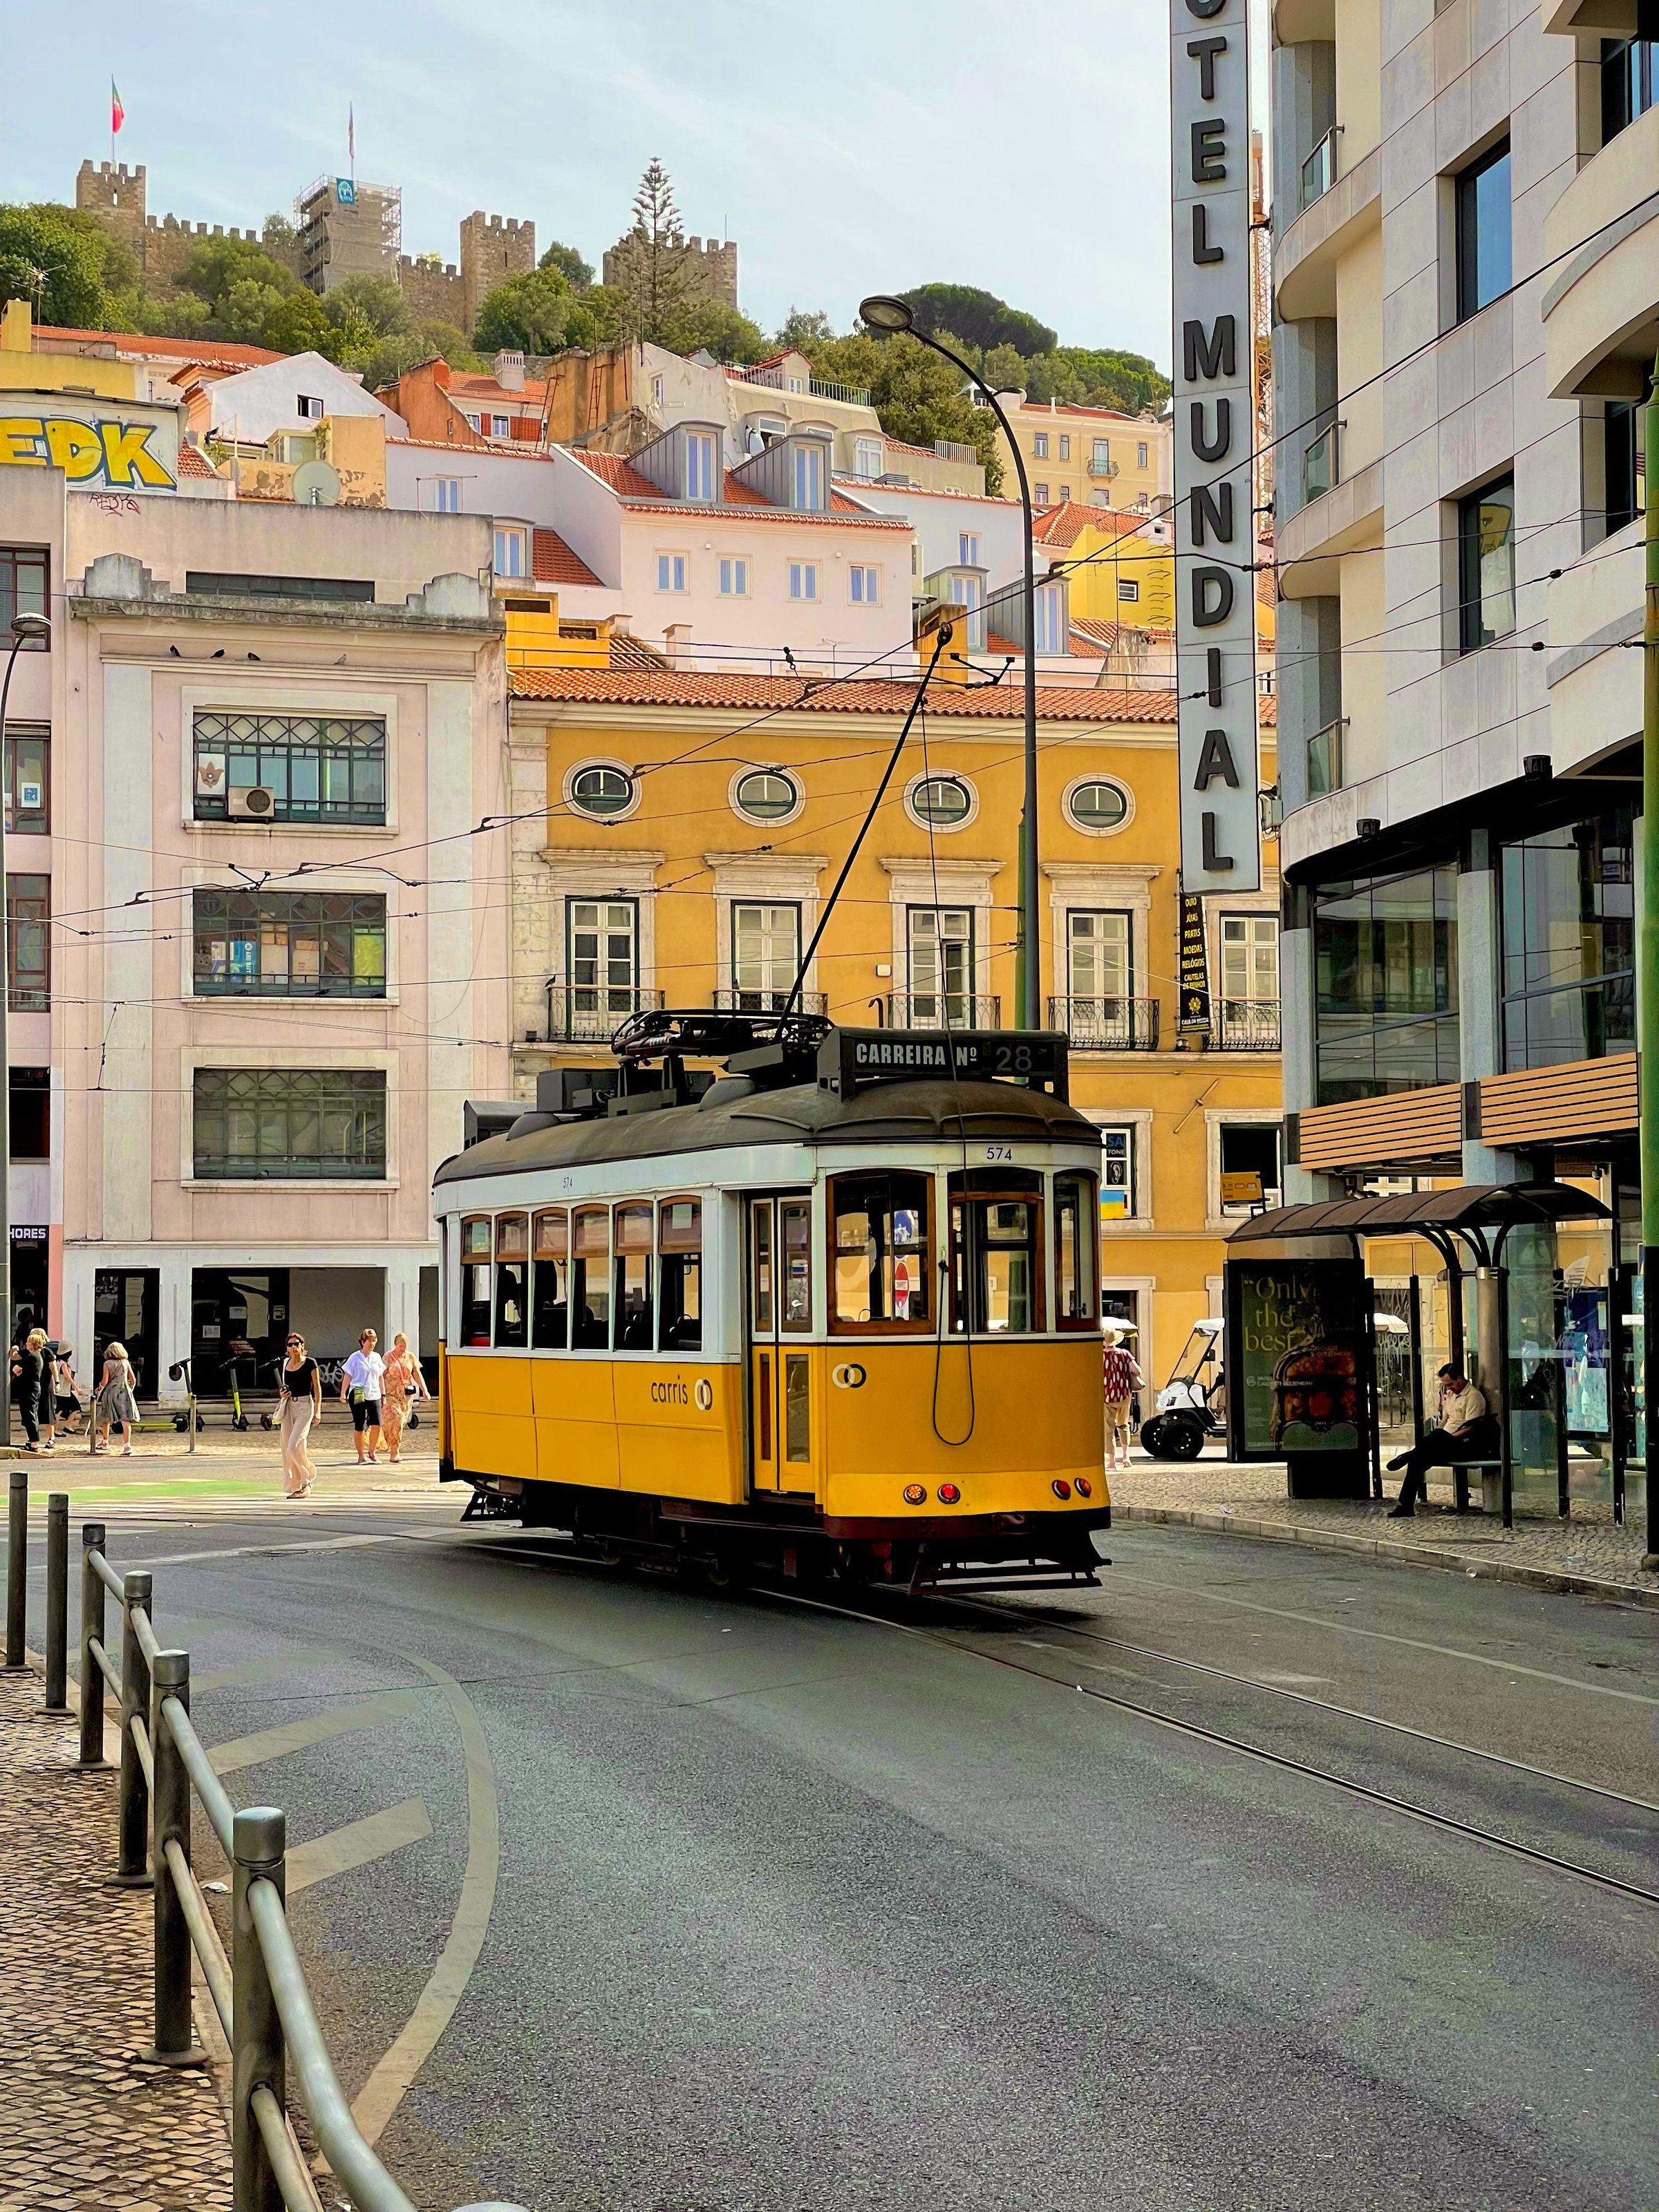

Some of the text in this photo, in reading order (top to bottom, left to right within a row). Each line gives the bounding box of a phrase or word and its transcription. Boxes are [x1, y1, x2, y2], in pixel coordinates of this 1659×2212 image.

[1183, 315, 1240, 870] MUNDIAL
[1183, 944, 1203, 955] MOEDAS
[1182, 958, 1205, 968] RELÓGIOS
[856, 1044, 946, 1065] CARREIRA
[996, 1046, 1033, 1072] 28
[986, 1147, 1012, 1161] 574
[563, 1177, 573, 1188] 574
[650, 1374, 688, 1405] carris
